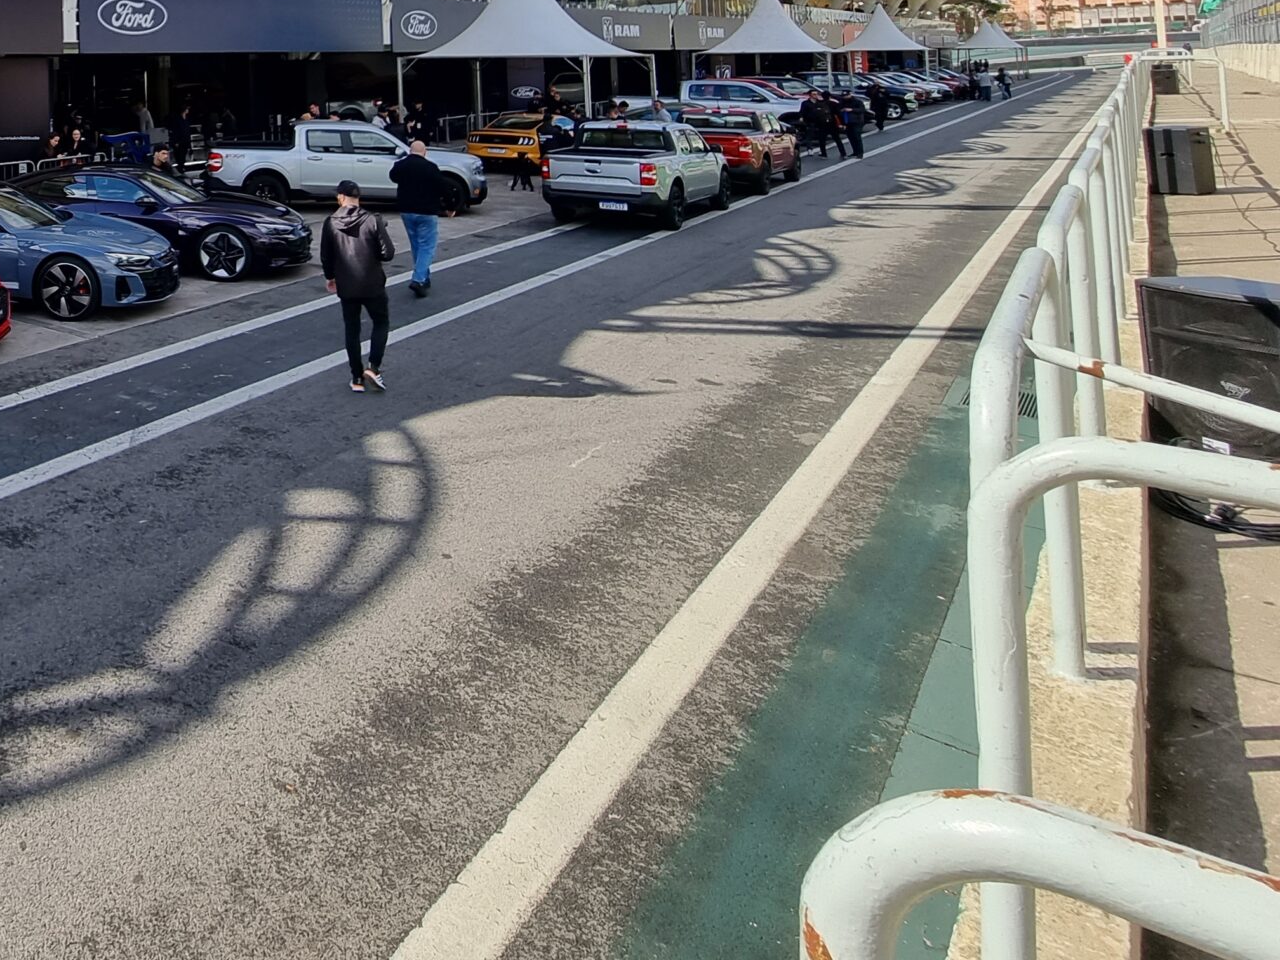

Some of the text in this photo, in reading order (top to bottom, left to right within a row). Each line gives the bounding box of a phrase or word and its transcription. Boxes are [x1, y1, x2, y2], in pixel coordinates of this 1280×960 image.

[111, 0, 155, 28] Ford
[408, 14, 431, 35] Ford
[614, 24, 640, 38] RAM
[706, 27, 725, 38] RAM
